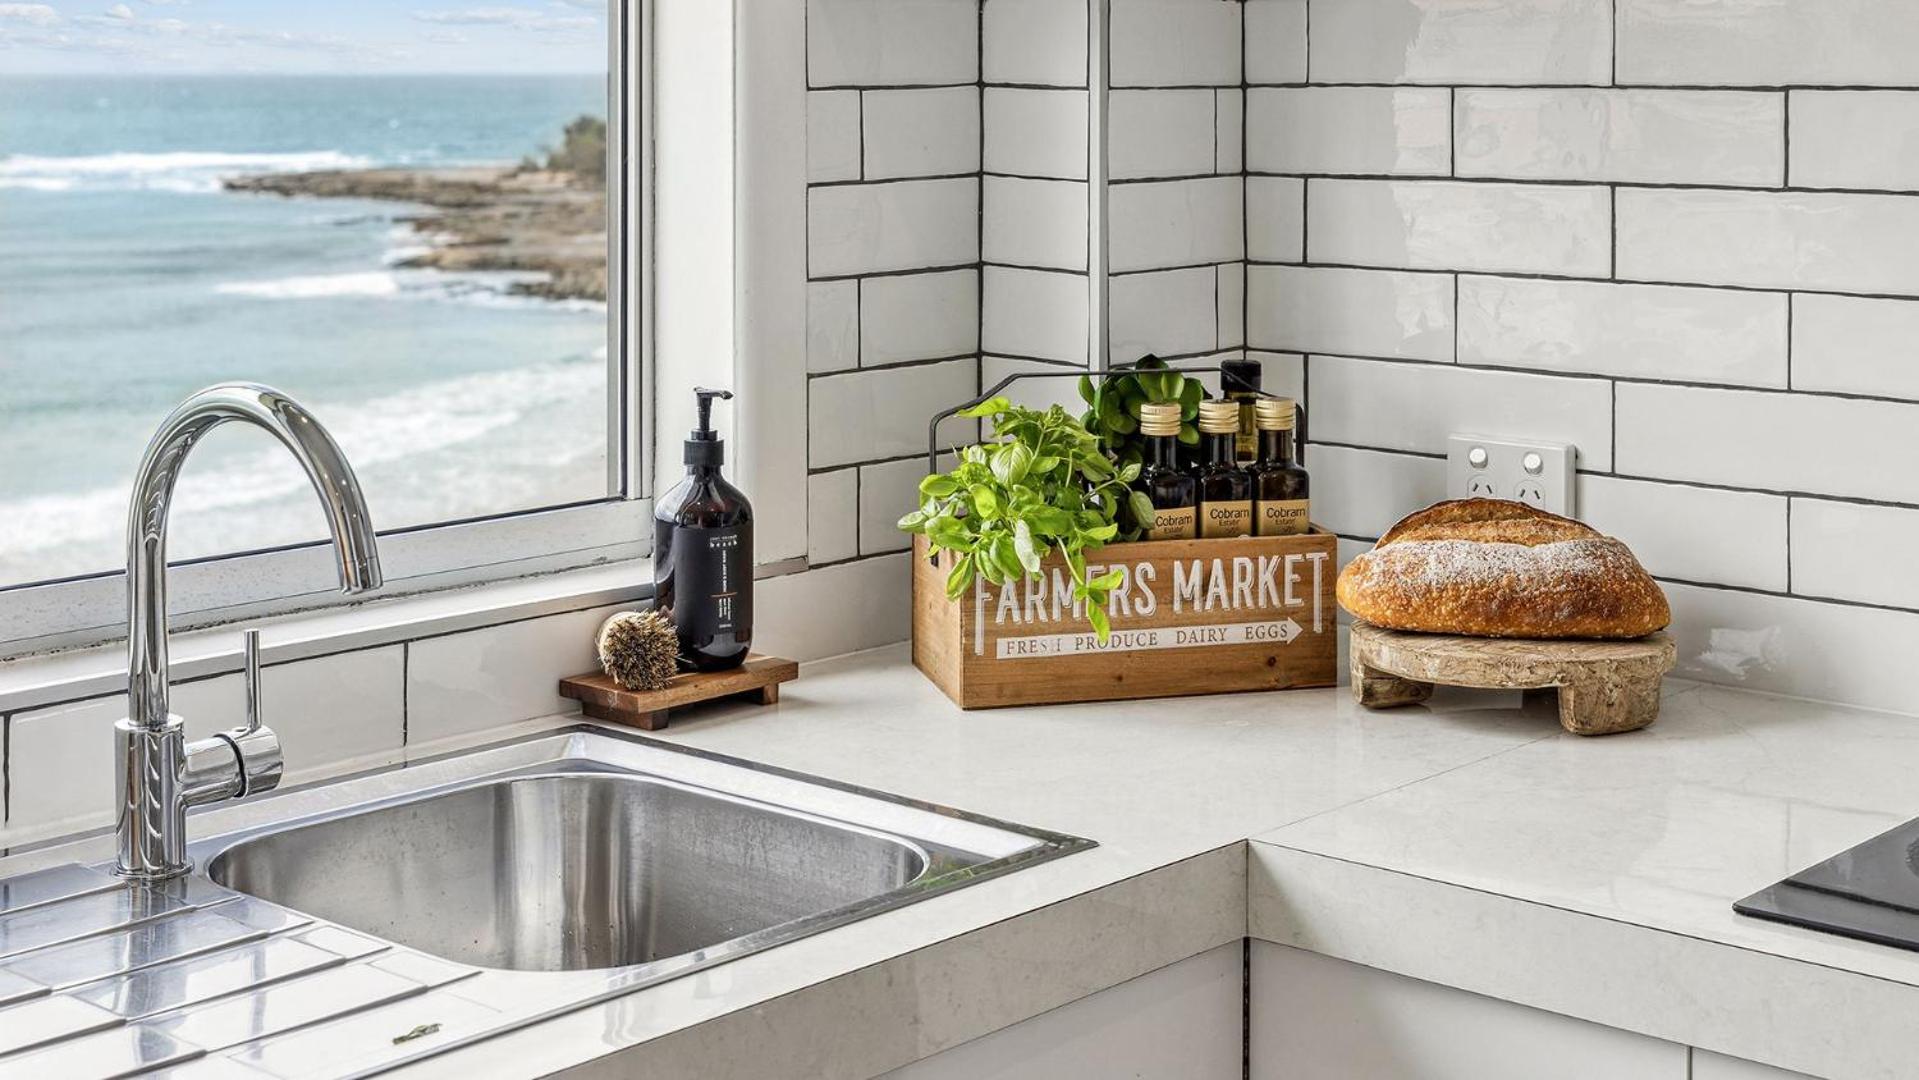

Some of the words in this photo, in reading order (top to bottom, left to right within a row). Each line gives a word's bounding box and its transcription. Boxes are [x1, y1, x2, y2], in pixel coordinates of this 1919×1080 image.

[1209, 508, 1250, 519] Cobram
[1266, 507, 1306, 519] Cobram
[1155, 514, 1193, 527] Cobram
[1173, 552, 1330, 633] MARKET
[1075, 632, 1158, 650] PRODUCE
[1176, 627, 1228, 644] DAIRY
[1245, 623, 1288, 640] EGGS
